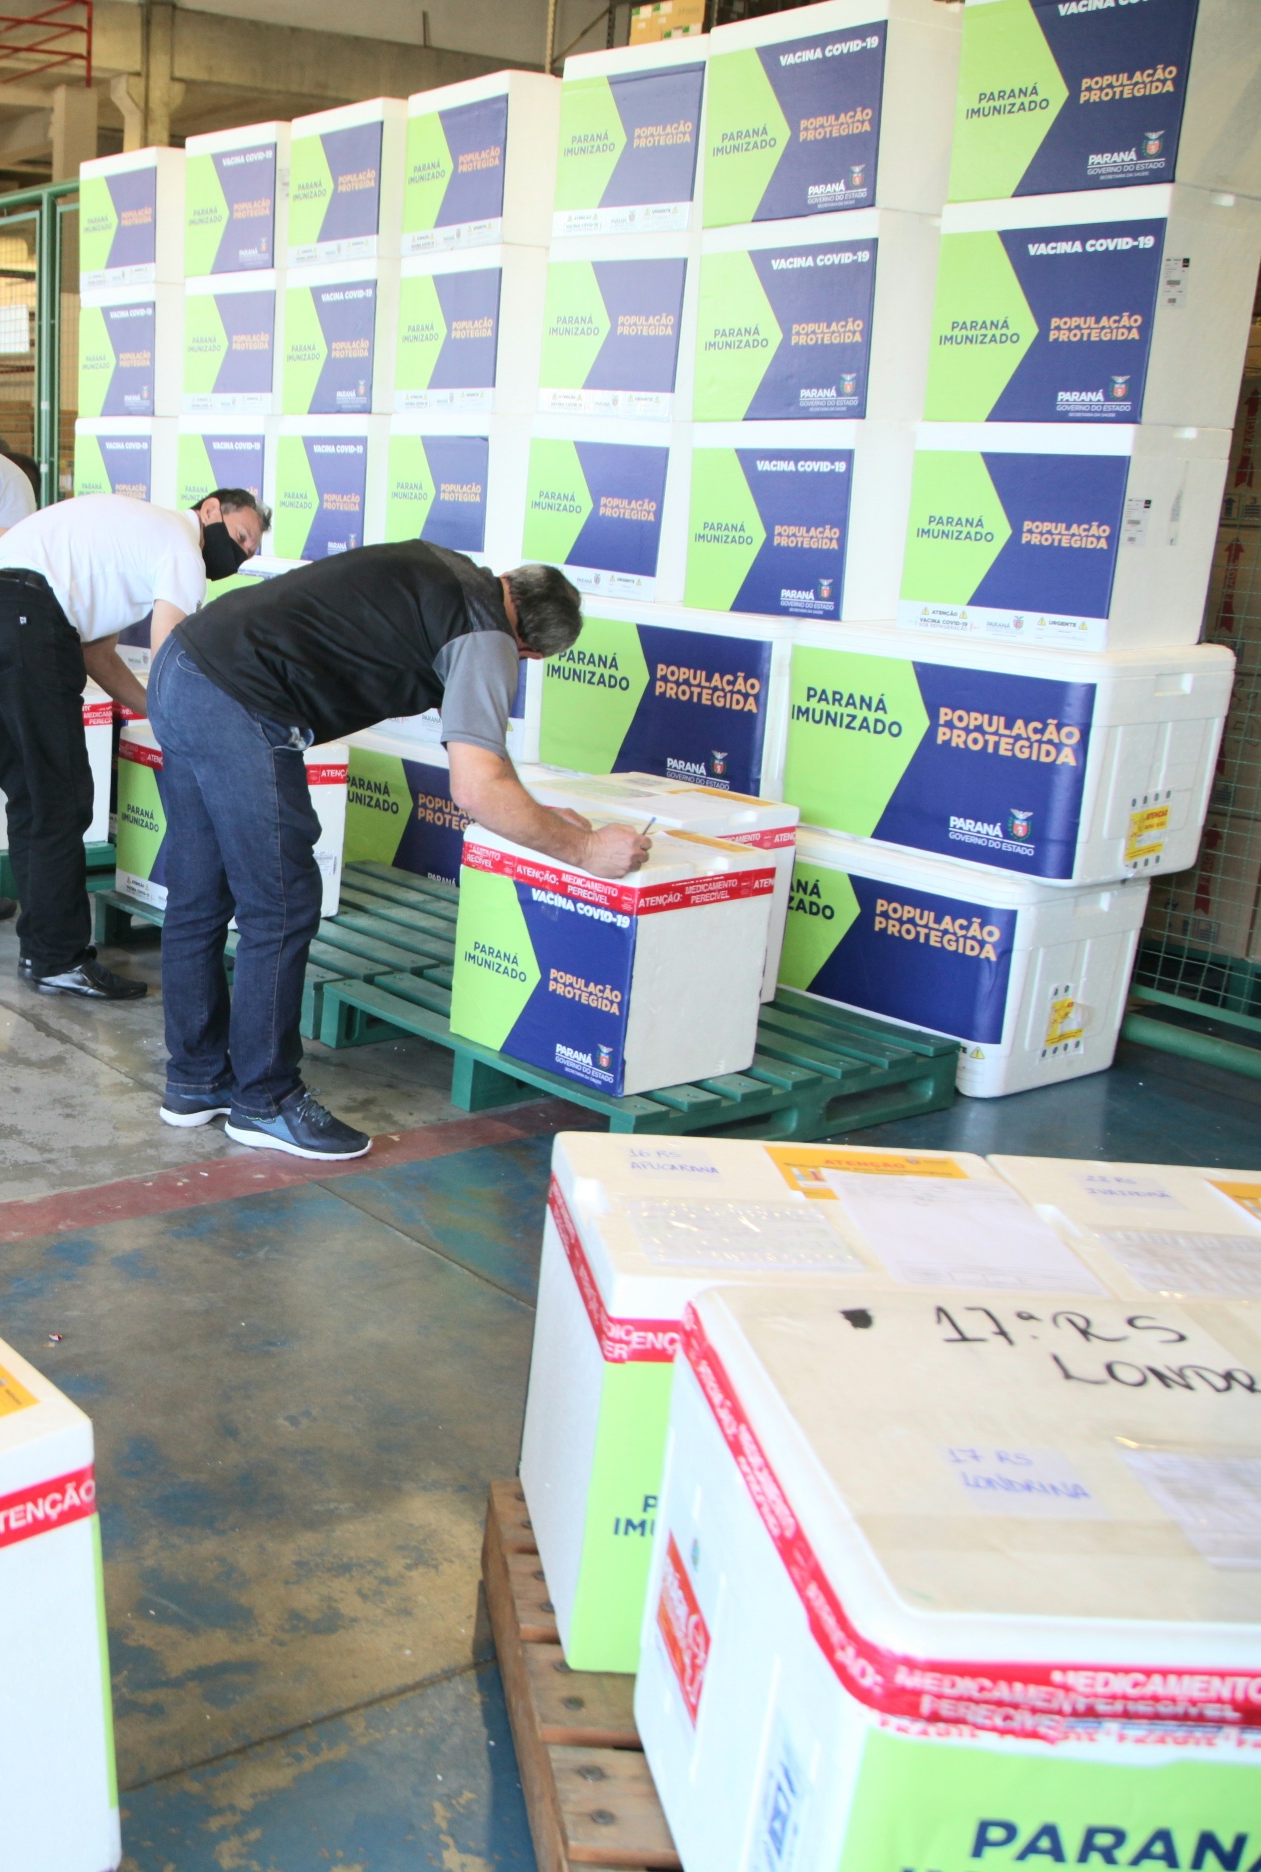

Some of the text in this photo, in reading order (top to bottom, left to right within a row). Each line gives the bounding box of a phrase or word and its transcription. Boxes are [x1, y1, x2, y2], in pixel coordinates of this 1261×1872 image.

[1058, 0, 1115, 16] VACINA
[779, 36, 879, 66] VACINA COVID-19
[1081, 65, 1177, 91] POPULAÇÃO
[978, 82, 1039, 104] PARANÁ
[1079, 80, 1175, 104] PROTEGIDA
[965, 98, 1049, 120] IMUNIZADO
[800, 108, 872, 131] POPULAÇÃO
[635, 121, 692, 138] POPULAÇÃO
[721, 124, 768, 142] PARANÁ
[799, 120, 871, 142] PROTEGIDA
[633, 132, 691, 149] PROTEGIDA
[713, 137, 777, 157] IMUNIZADO
[459, 146, 500, 163] POPULAÇÃO
[563, 142, 615, 157] IMUNIZADO
[1089, 148, 1137, 166] PARANÁ
[458, 157, 499, 173] PROTEGIDA
[1087, 161, 1165, 176] GOVERNO DO ESTADO
[808, 179, 845, 195] PARANÁ
[1028, 236, 1154, 256] VACINA COVID-19
[771, 250, 869, 270] VACINA COVID-19
[321, 288, 372, 302] VACINA COVID-19
[453, 317, 493, 329] POPULAÇÃO
[557, 316, 593, 326] PARANÁ
[618, 314, 674, 326] POPULAÇÃO
[792, 319, 863, 334] POPULAÇÃO
[951, 316, 1010, 332] PARANÁ
[1051, 313, 1142, 330] POPULAÇÃO
[452, 328, 491, 338] PROTEGIDA
[549, 326, 600, 336] IMUNIZADO
[617, 324, 673, 336] PROTEGIDA
[713, 324, 761, 338] PARANÁ
[791, 330, 862, 346] PROTEGIDA
[1049, 327, 1139, 342] PROTEGIDA
[705, 337, 769, 351] IMUNIZADO
[939, 332, 1019, 346] IMUNIZADO
[800, 386, 837, 398] PARANÁ
[1057, 390, 1104, 402] PARANÁ
[1057, 404, 1131, 412] GOVERNO DO ESTADO
[213, 442, 260, 450] VACINA COVID-19
[313, 444, 363, 454] VACINA COVID-19
[757, 460, 845, 472] VACINA COVID-19
[441, 482, 481, 493] POPULAÇÃO
[539, 490, 575, 502] PARANÁ
[441, 492, 481, 502] PROTEGIDA
[600, 496, 657, 512] POPULAÇÃO
[531, 500, 582, 514] IMUNIZADO
[599, 507, 655, 522] PROTEGIDA
[703, 520, 745, 534] PARANÁ
[928, 515, 984, 529] PARANÁ
[1023, 520, 1110, 537] POPULAÇÃO
[694, 533, 753, 546] IMUNIZADO
[775, 524, 839, 540] POPULAÇÃO
[917, 528, 994, 542] IMUNIZADO
[773, 536, 839, 550] PROTEGIDA
[1022, 533, 1108, 550] PROTEGIDA
[781, 588, 814, 600] PARANÁ
[781, 600, 804, 608] GOVERNO
[815, 602, 834, 610] ESTADO
[1049, 620, 1077, 628] URGENTE
[558, 651, 619, 670] PARANÁ
[547, 664, 629, 691] IMUNIZADO
[657, 664, 760, 694] POPULAÇÃO
[655, 681, 757, 713] PROTEGIDA
[806, 686, 887, 714] PARANÁ
[792, 704, 902, 738] IMUNIZADO
[939, 707, 1079, 746] POPULAÇÃO
[937, 727, 1077, 766] PROTEGIDA
[667, 758, 706, 775] PARANÁ
[347, 775, 390, 797] PARANÁ
[667, 771, 729, 790] GOVERNO DO ESTADO
[347, 790, 399, 814] UNIZADO
[127, 804, 154, 820] PARANÁ
[122, 813, 159, 832] IMUNIZADO
[949, 816, 1003, 838] PARANÁ
[949, 832, 1034, 856] GOVERNO DO ESTADO
[517, 864, 618, 896] ATENÇÃO: MEDICAMENTO
[567, 885, 609, 905] PERECÍVEL
[639, 893, 682, 908] ATENÇÃO:
[685, 879, 737, 894] MEDICAMENTO
[753, 878, 774, 889] ATEN
[691, 890, 729, 904] PERECÍVEL
[532, 888, 630, 928] VACINA COVID-19
[876, 899, 1001, 942] POPULAÇÃO
[875, 916, 997, 961] PROTEGIDA
[474, 942, 519, 966] PARANÁ
[465, 952, 527, 982] IMUNIZADO
[550, 968, 621, 1002] POPULAÇÃO
[549, 980, 619, 1015] PROTEGIDA
[556, 1044, 593, 1066] PARANÁ
[555, 1056, 613, 1083] GOVERNO DO ESTADO
[631, 1162, 719, 1174] APUCARANA
[825, 1158, 905, 1170] ATENÇÃO
[1051, 1353, 1261, 1394] LONDR
[949, 1448, 1032, 1466] 17 RS
[961, 1472, 1091, 1500] LONDRINA
